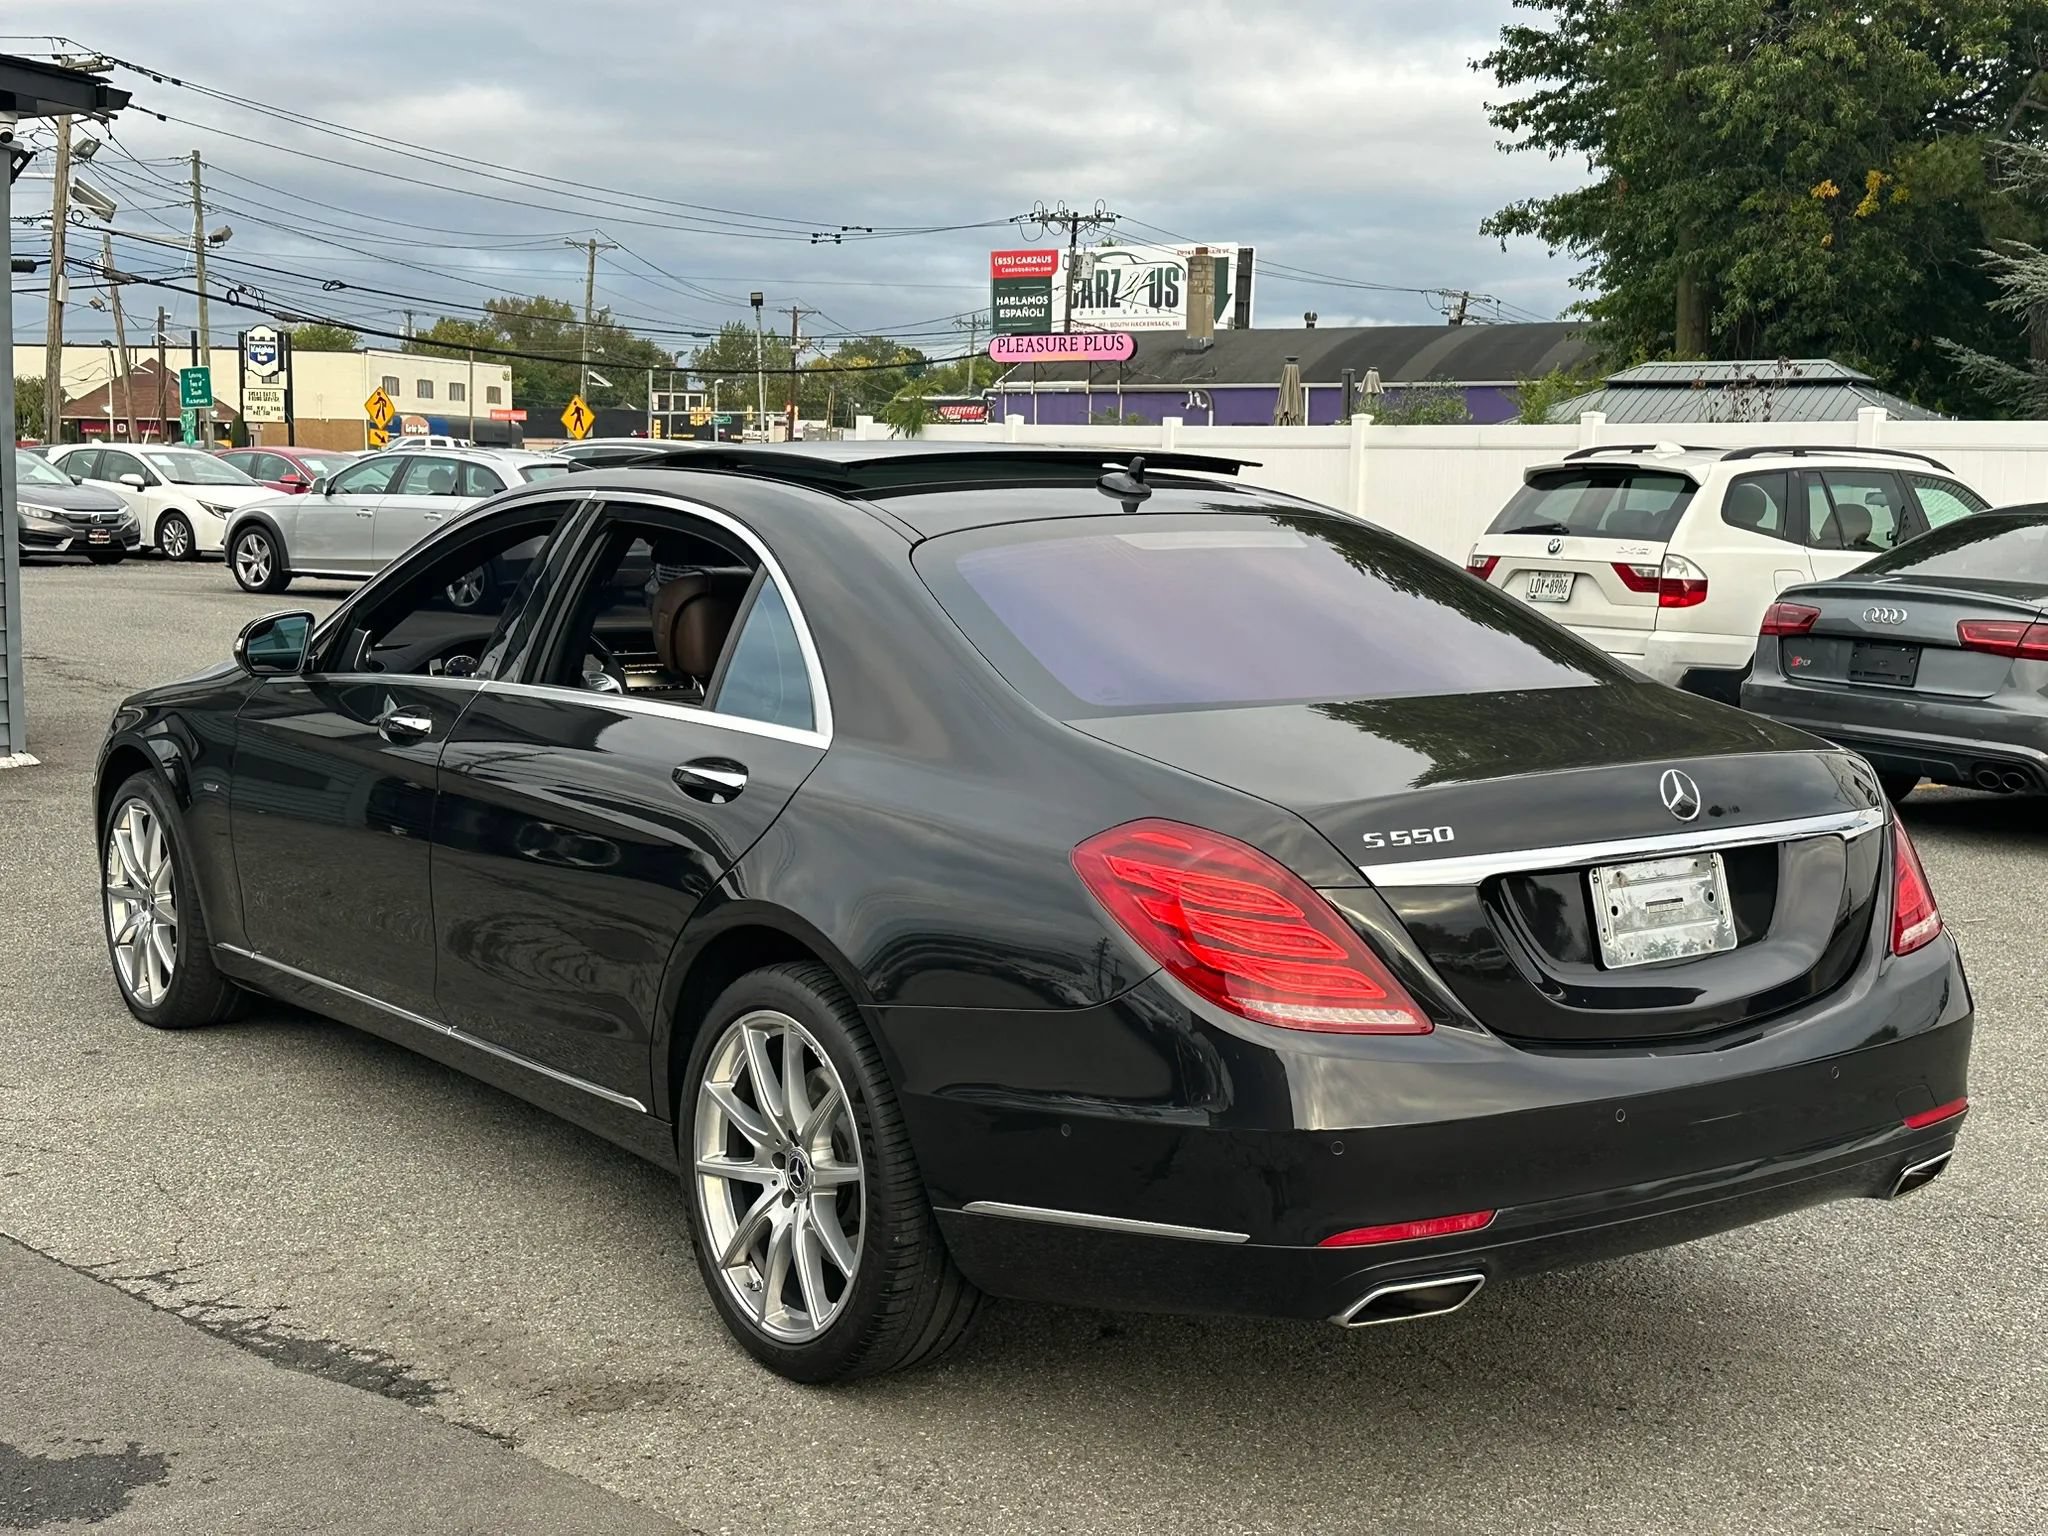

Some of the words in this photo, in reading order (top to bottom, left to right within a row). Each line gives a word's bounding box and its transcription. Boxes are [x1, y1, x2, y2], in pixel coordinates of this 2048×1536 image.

[996, 296, 1049, 306] HABLAMOS
[997, 336, 1079, 353] PLEASURE
[1084, 335, 1124, 352] PLUS
[1362, 832, 1385, 849] S
[1389, 825, 1455, 847] 550
